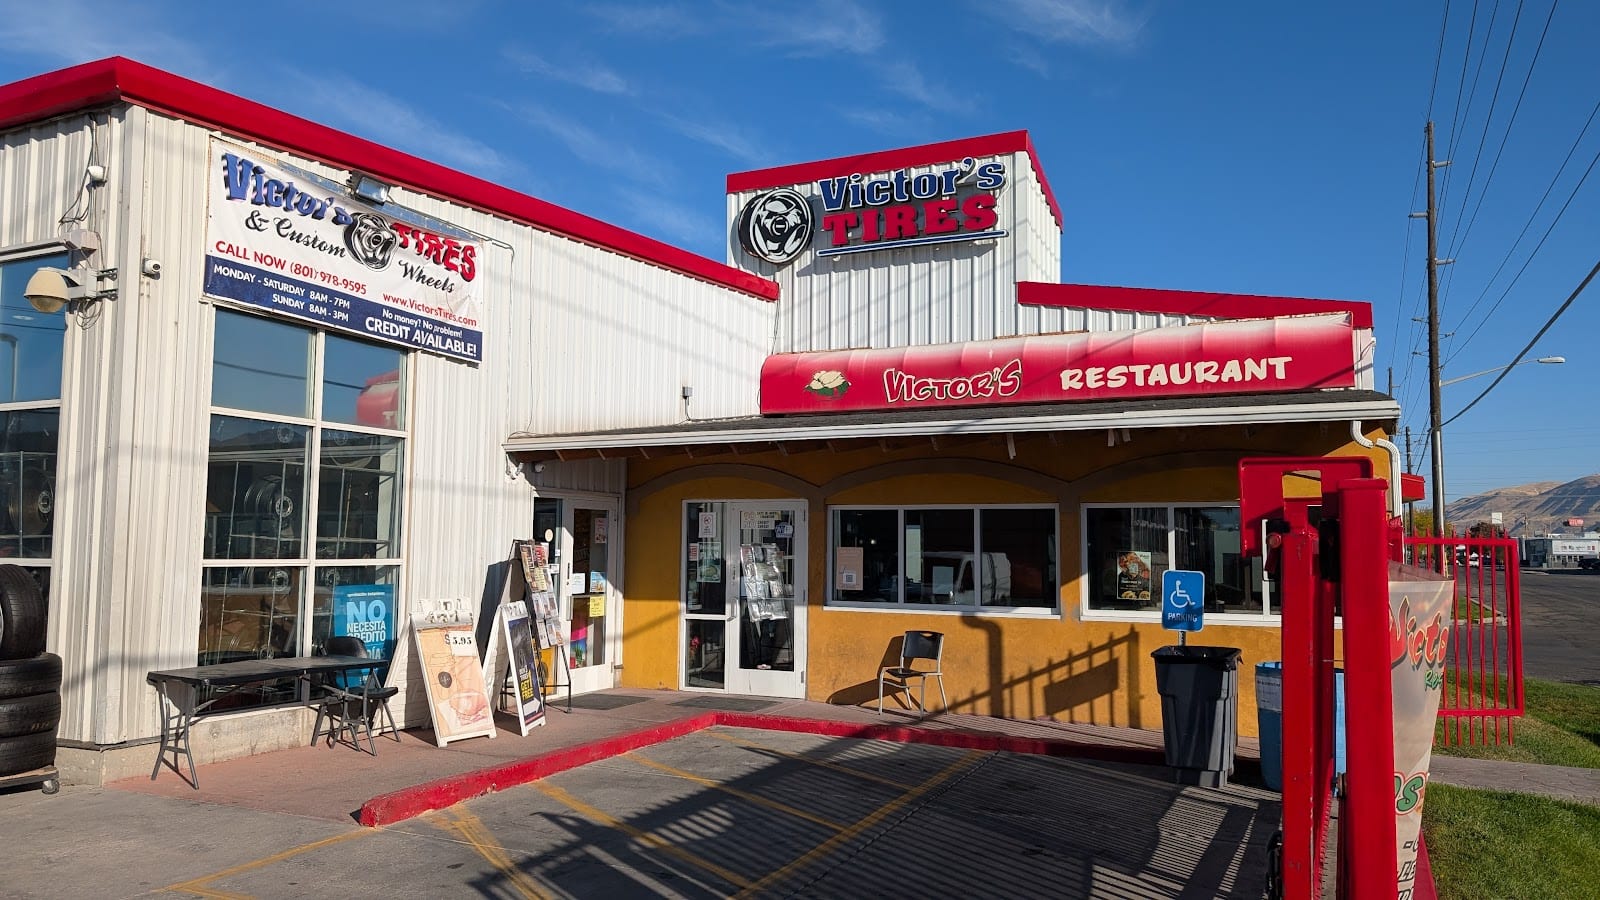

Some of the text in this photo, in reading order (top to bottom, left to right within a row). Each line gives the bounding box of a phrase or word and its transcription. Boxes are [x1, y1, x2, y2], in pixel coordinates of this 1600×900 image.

[818, 156, 1006, 211] Victor's
[221, 153, 476, 282] Victor's TIRES
[245, 210, 346, 258] & Custom
[823, 194, 998, 246] TIRES
[215, 241, 250, 260] CALL
[253, 251, 287, 270] NOW
[213, 264, 256, 283] MONDAY
[263, 277, 305, 296] SATURDAY
[309, 290, 328, 303] 8AM
[334, 297, 350, 309] 7PM
[398, 259, 455, 293] Wheels
[272, 293, 305, 310] SUNDAY
[309, 302, 327, 316] 8AM
[332, 309, 349, 321] 3PM
[382, 293, 477, 327] www.VictorsTires.com
[382, 308, 463, 338] No money? No problem!
[365, 316, 477, 357] CREDIT AVAILABLE!
[1060, 356, 1293, 390] RESTAURANT
[346, 600, 386, 622] NO
[346, 621, 386, 633] NECESITA
[1167, 612, 1198, 623] PARKING
